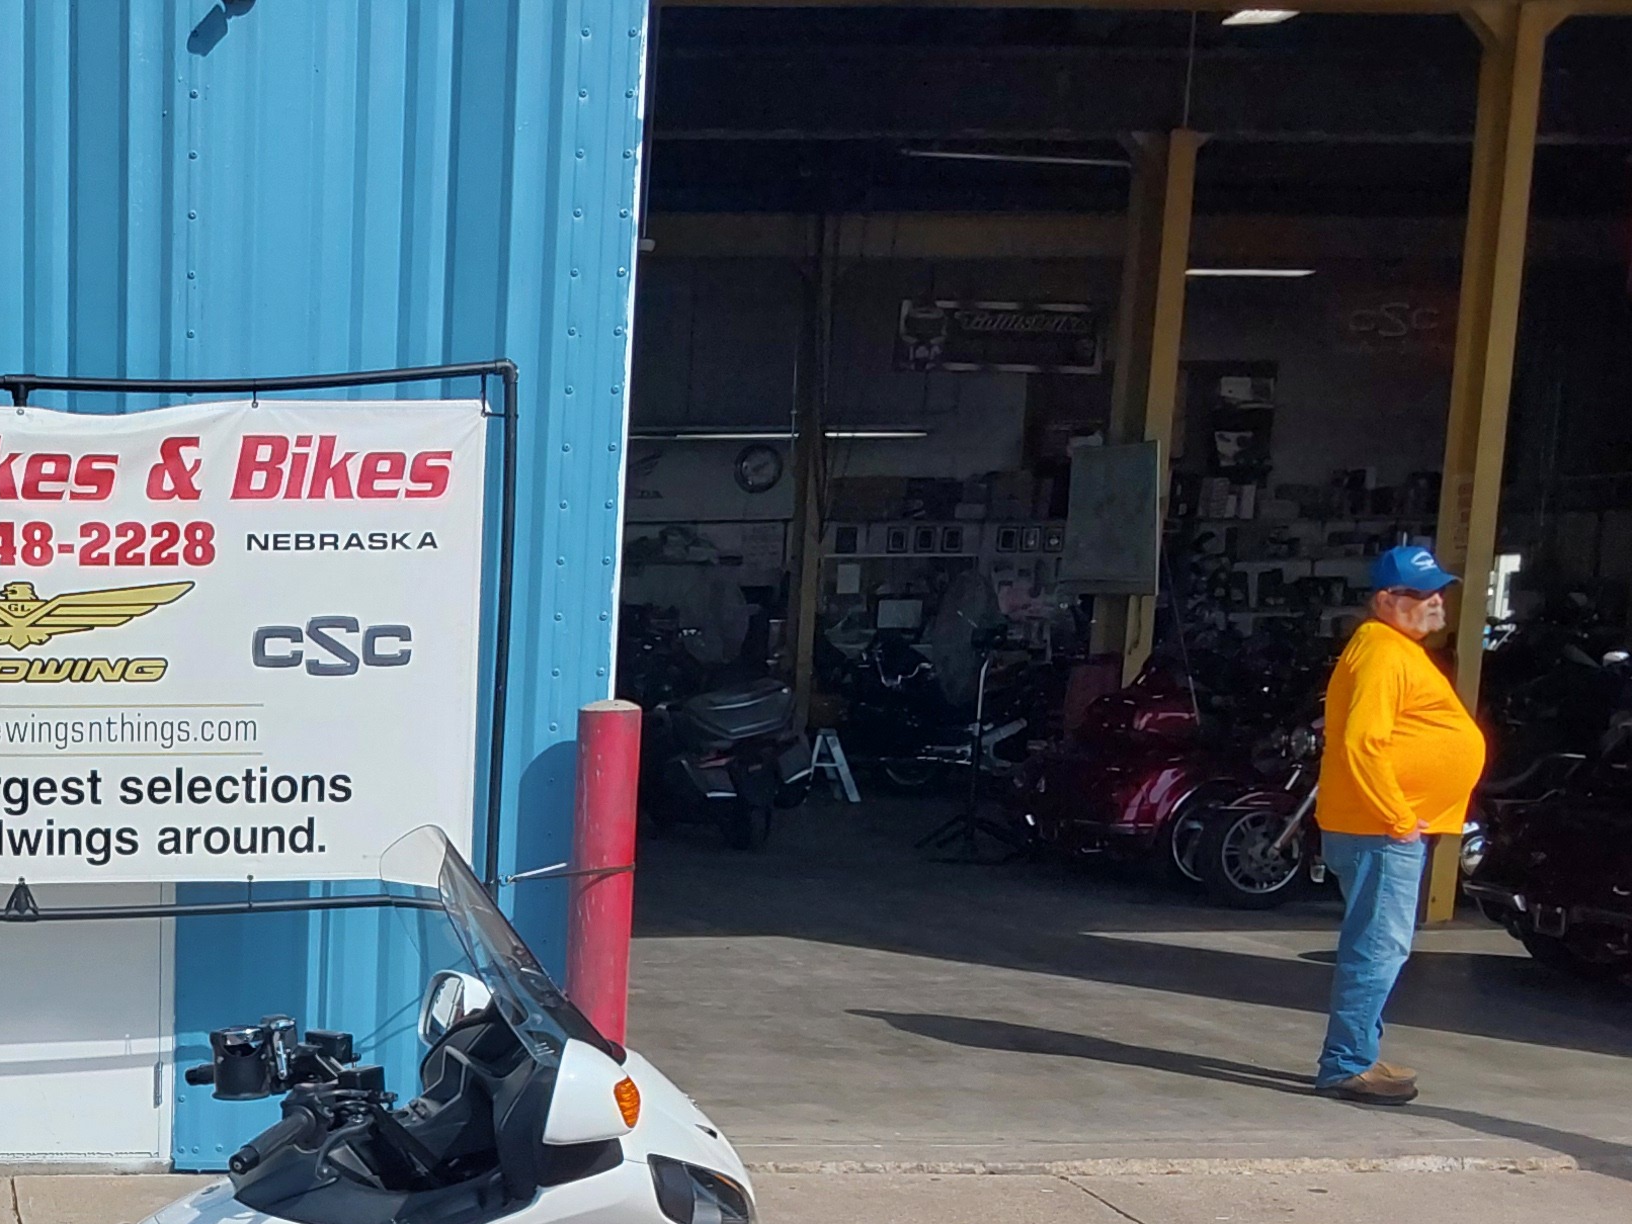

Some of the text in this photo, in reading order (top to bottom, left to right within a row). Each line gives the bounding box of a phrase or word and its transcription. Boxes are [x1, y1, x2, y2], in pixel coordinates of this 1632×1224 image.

[145, 435, 203, 501] &
[229, 434, 454, 501] Bikes
[246, 531, 439, 552] NEBRASKA
[7, 603, 32, 613] GL
[118, 766, 353, 805] selections
[157, 816, 327, 856] around.
